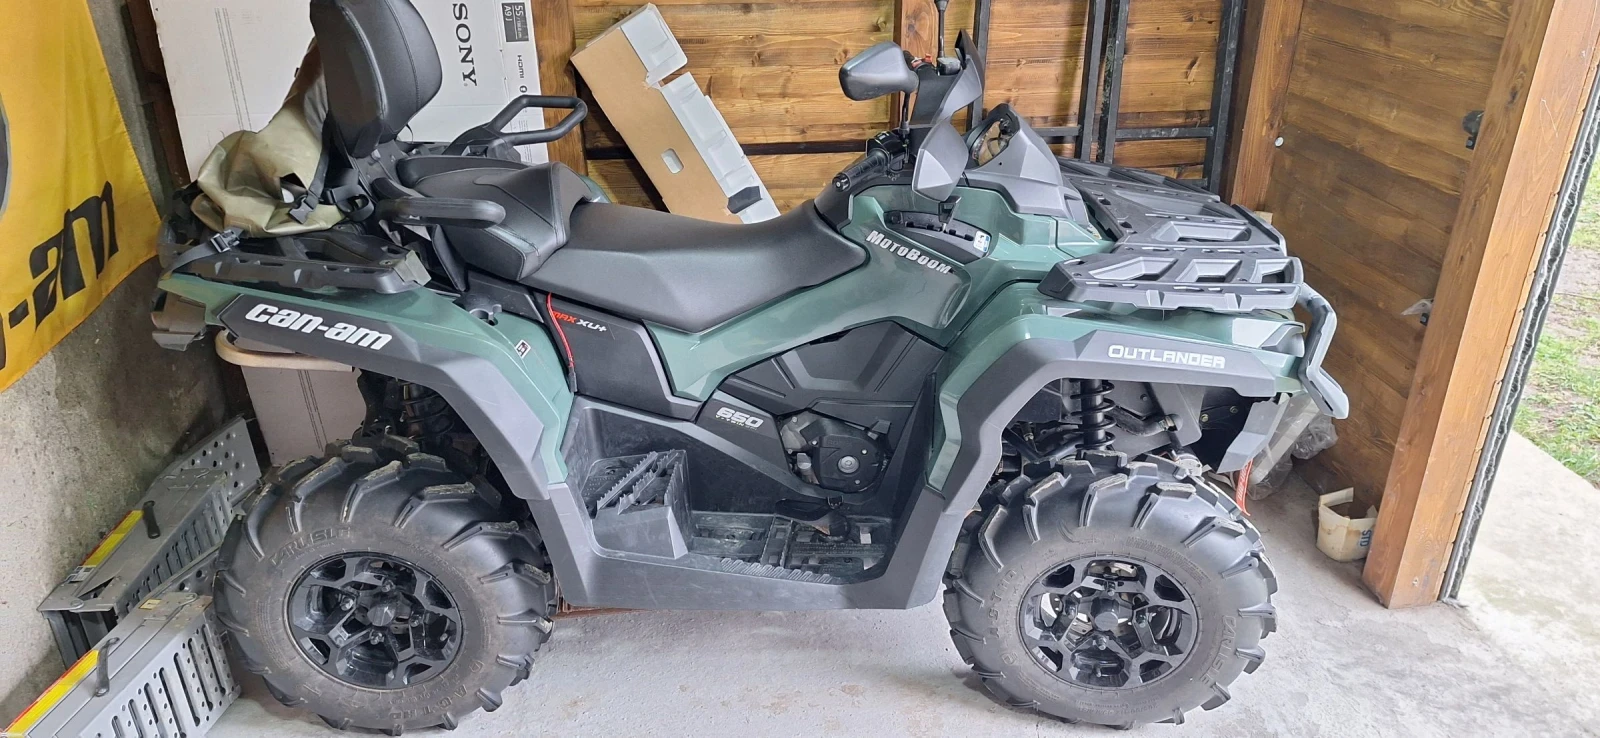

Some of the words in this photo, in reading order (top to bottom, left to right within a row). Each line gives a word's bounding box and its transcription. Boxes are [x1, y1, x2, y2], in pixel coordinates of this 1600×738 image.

[515, 5, 523, 16] 55
[452, 2, 477, 86] SONY
[0, 180, 119, 370] -am
[245, 303, 393, 351] can-am
[1107, 344, 1226, 369] OUTLANDER
[716, 406, 764, 428] 650
